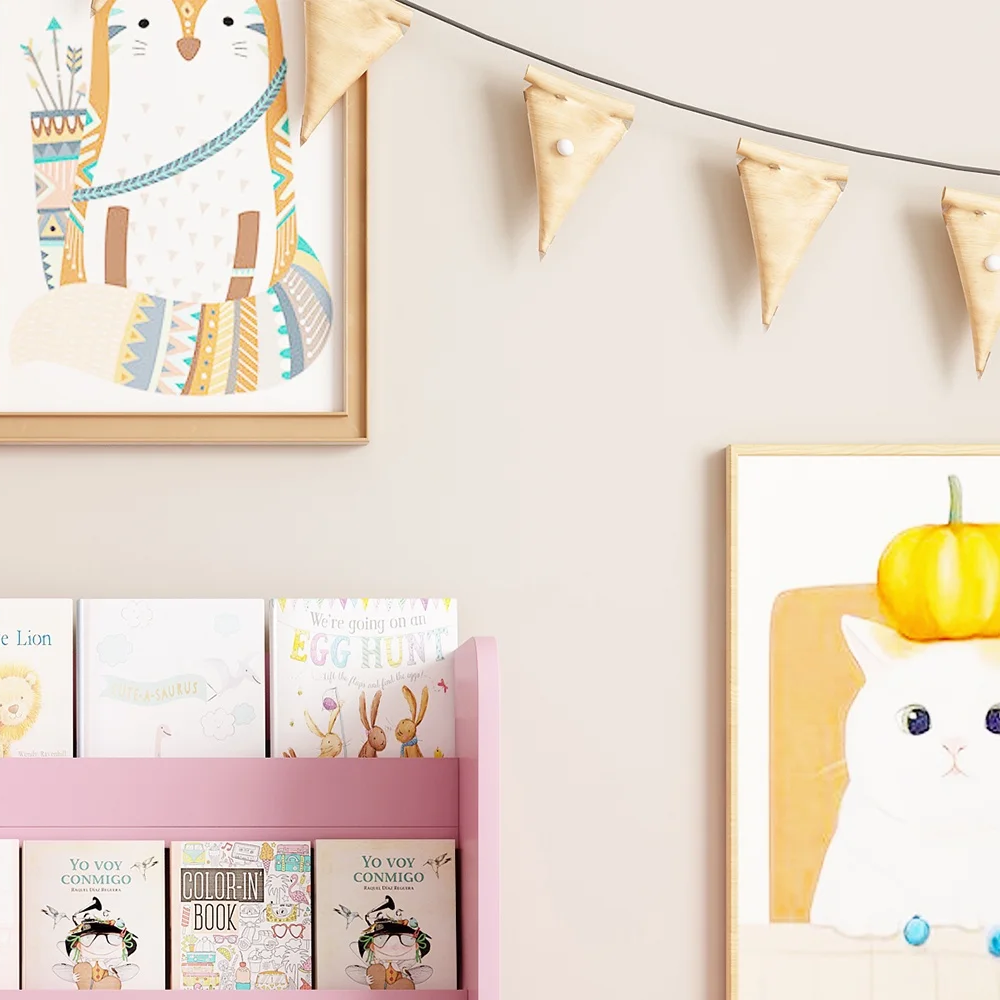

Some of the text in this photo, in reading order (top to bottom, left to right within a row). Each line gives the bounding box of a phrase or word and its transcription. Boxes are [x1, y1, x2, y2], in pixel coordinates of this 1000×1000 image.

[310, 611, 426, 634] We're going on an
[17, 630, 52, 646] Lion
[290, 627, 449, 669] EGG HUNT
[61, 874, 132, 885] CONMIGO
[353, 872, 424, 883] CONMIGO
[194, 904, 237, 931] BOOK
